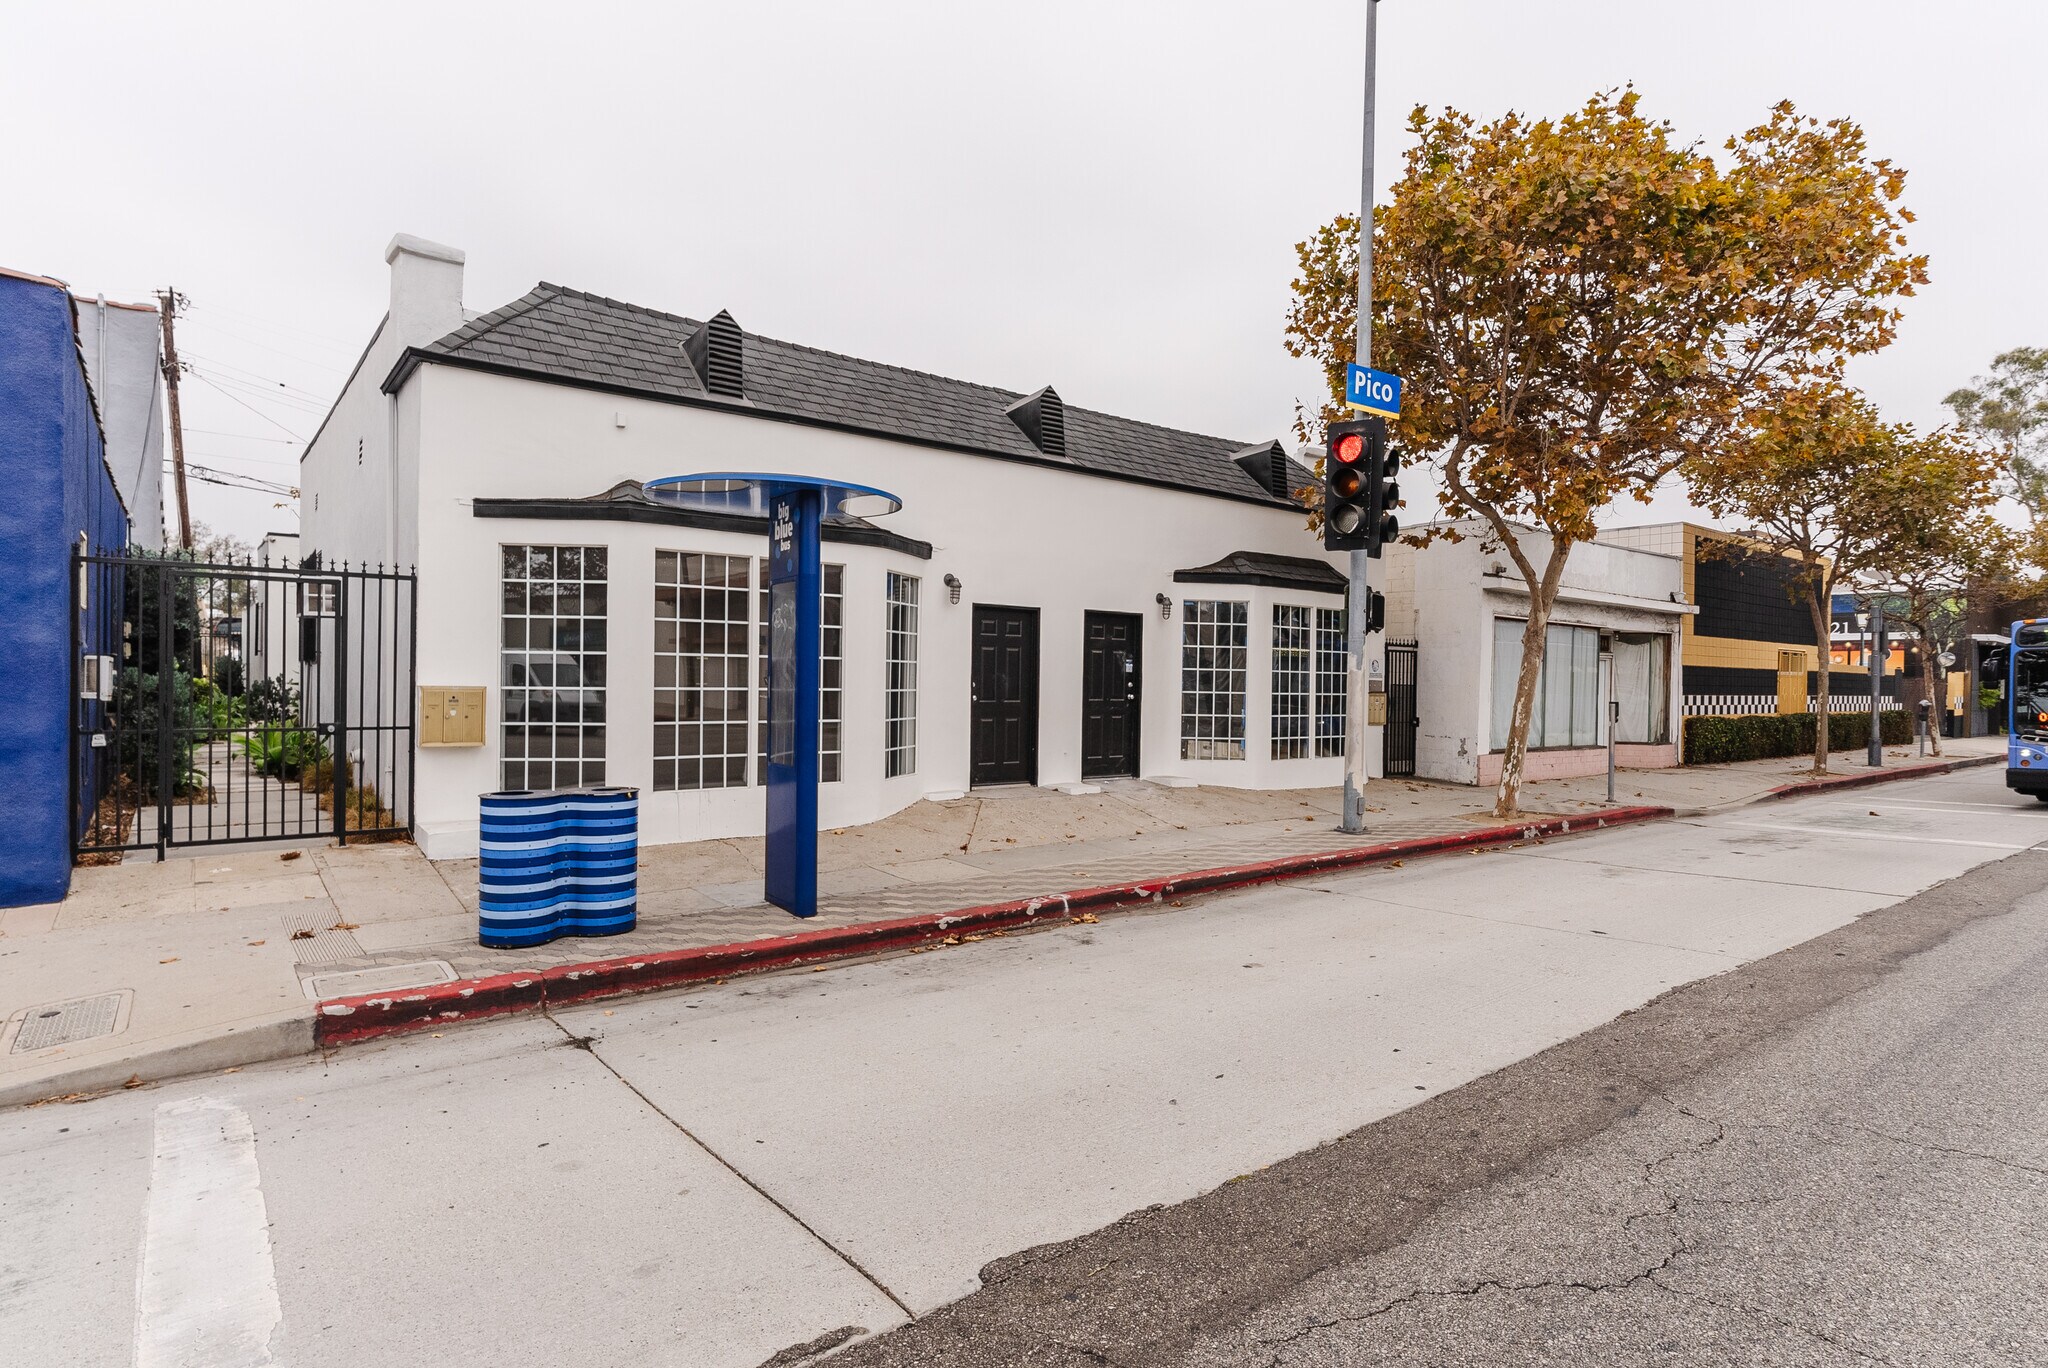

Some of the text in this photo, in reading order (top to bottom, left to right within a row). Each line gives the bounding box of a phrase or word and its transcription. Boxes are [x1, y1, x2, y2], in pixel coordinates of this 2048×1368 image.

[1355, 371, 1393, 402] Pico
[778, 501, 790, 522] big
[774, 519, 793, 541] blue
[780, 539, 791, 552] bus
